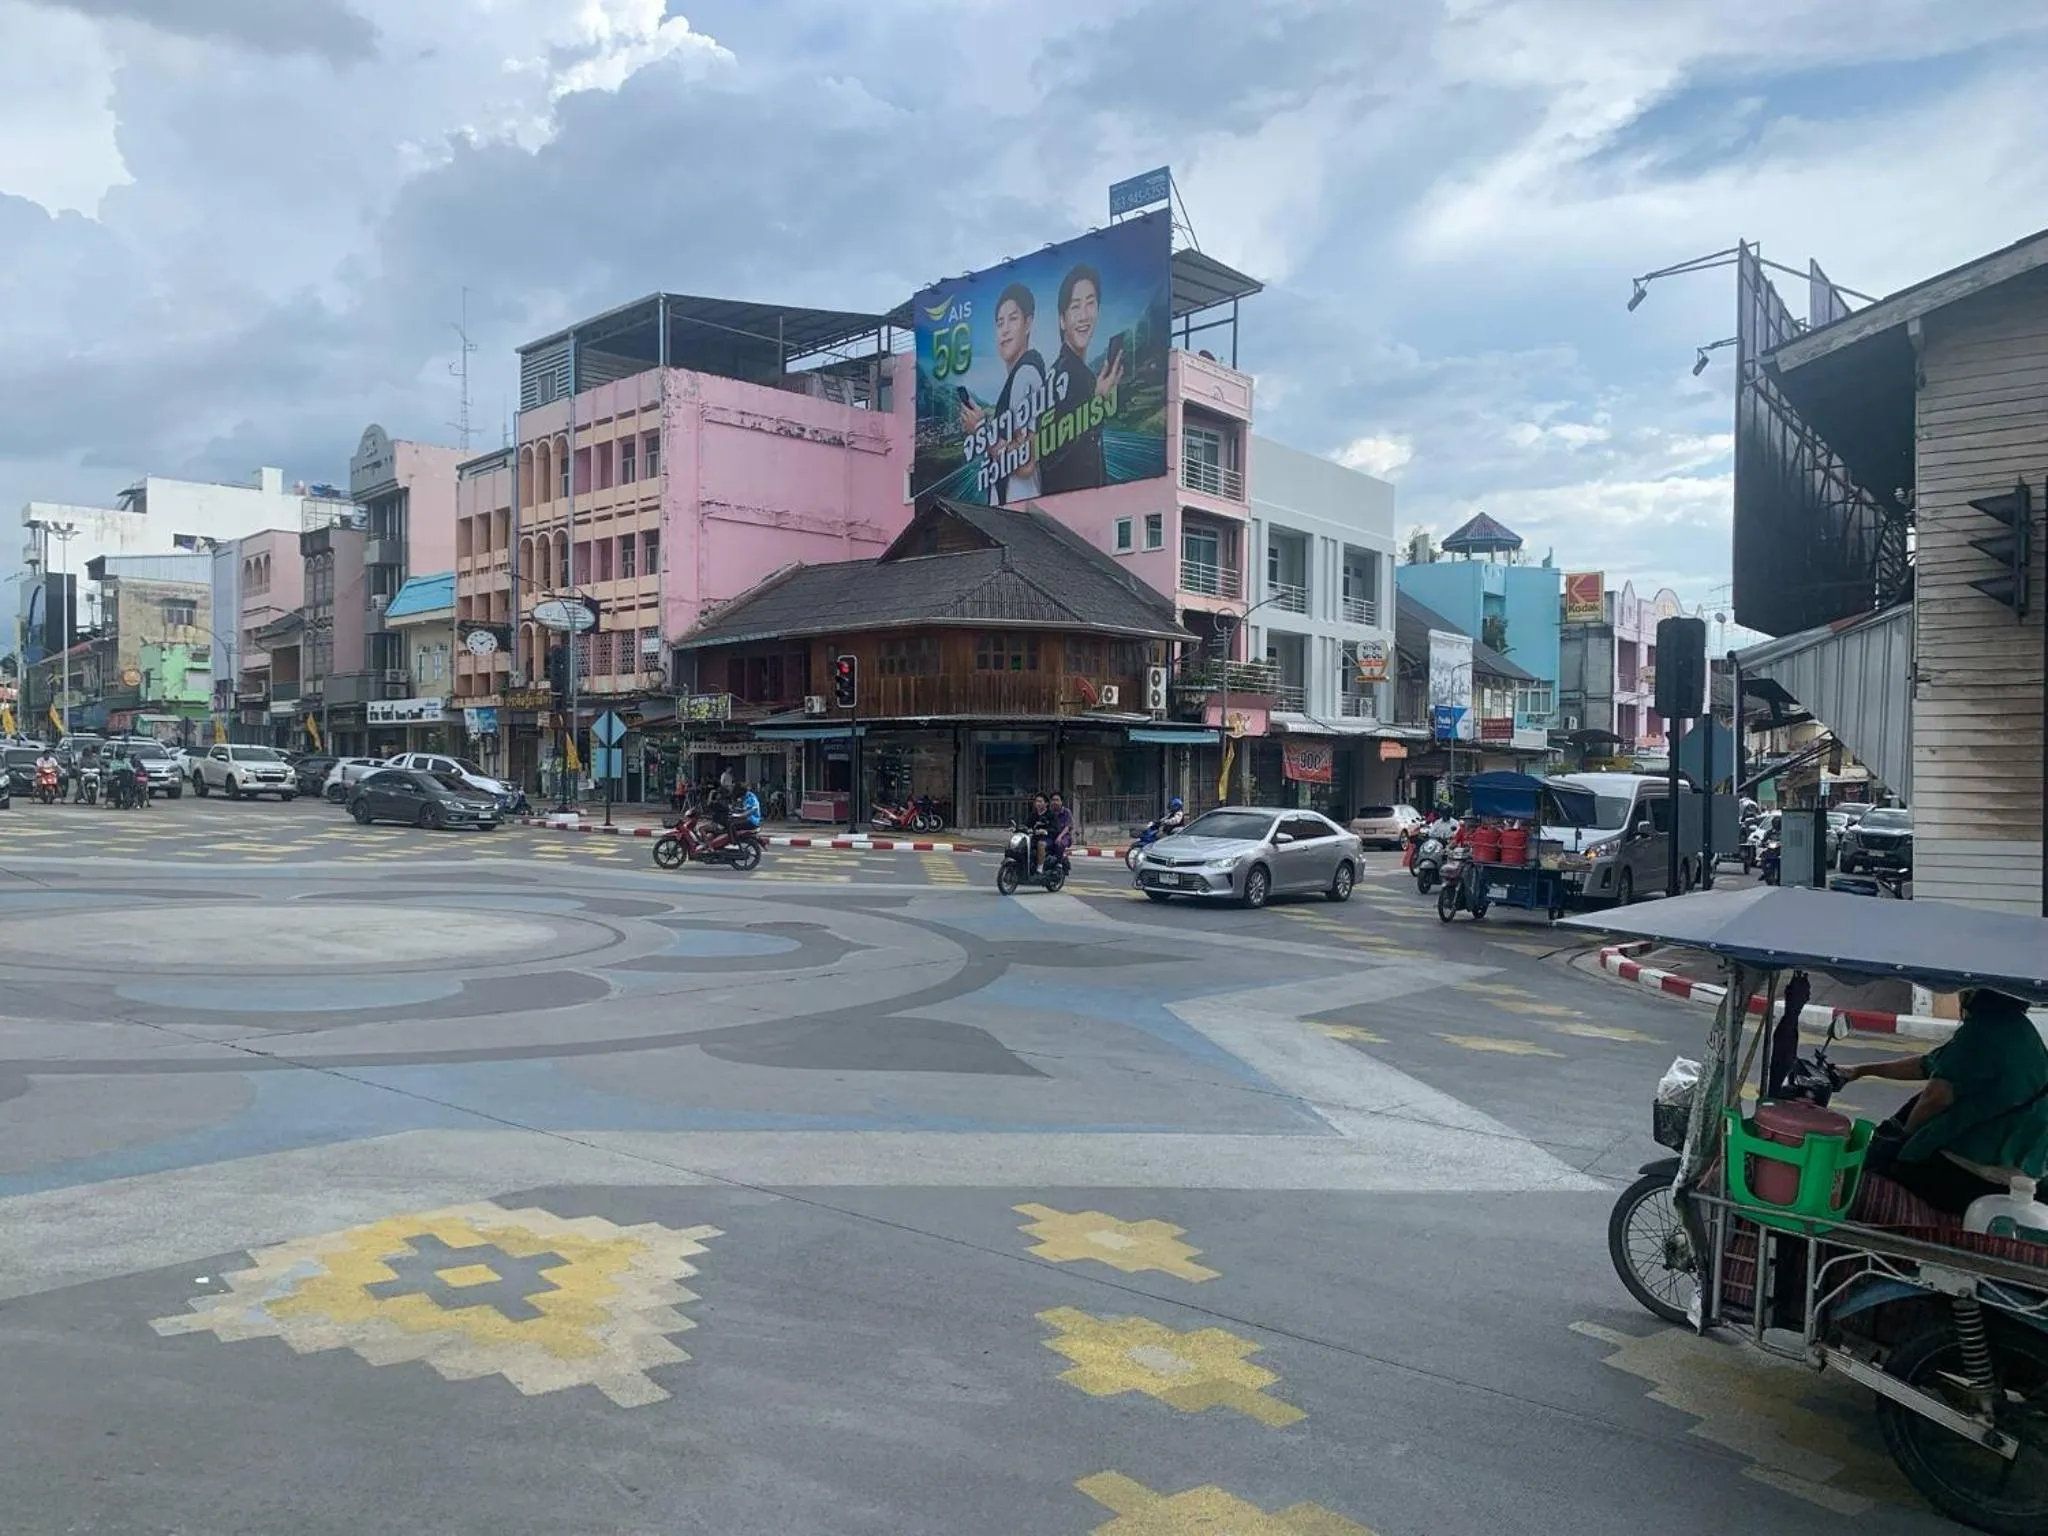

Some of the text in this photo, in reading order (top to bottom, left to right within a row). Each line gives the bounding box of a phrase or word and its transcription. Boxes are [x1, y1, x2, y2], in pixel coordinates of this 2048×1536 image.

[948, 301, 973, 323] AIS
[932, 322, 972, 379] 5G
[1568, 602, 1600, 613] Kodak
